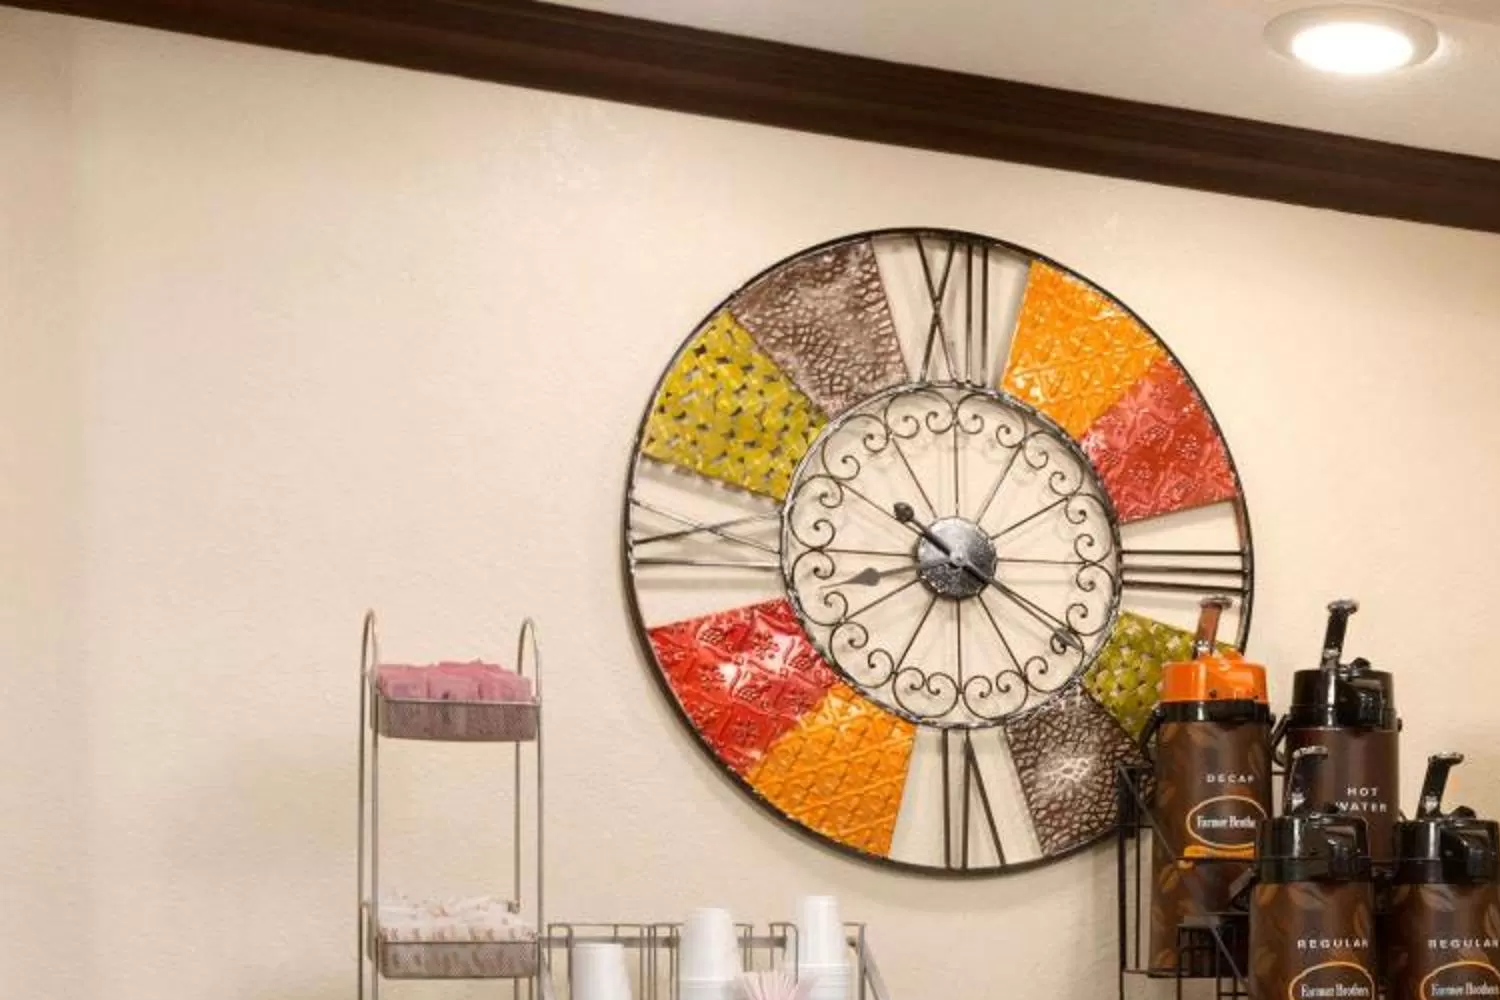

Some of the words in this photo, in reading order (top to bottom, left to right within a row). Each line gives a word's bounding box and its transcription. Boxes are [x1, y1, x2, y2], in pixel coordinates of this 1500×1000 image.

[1206, 773, 1255, 784] DECAF
[1346, 787, 1378, 797] HOT
[1335, 801, 1388, 813] WATER
[1196, 815, 1228, 829] Farmer
[1296, 938, 1369, 949] REGULAR
[1427, 938, 1500, 949] REGULAR
